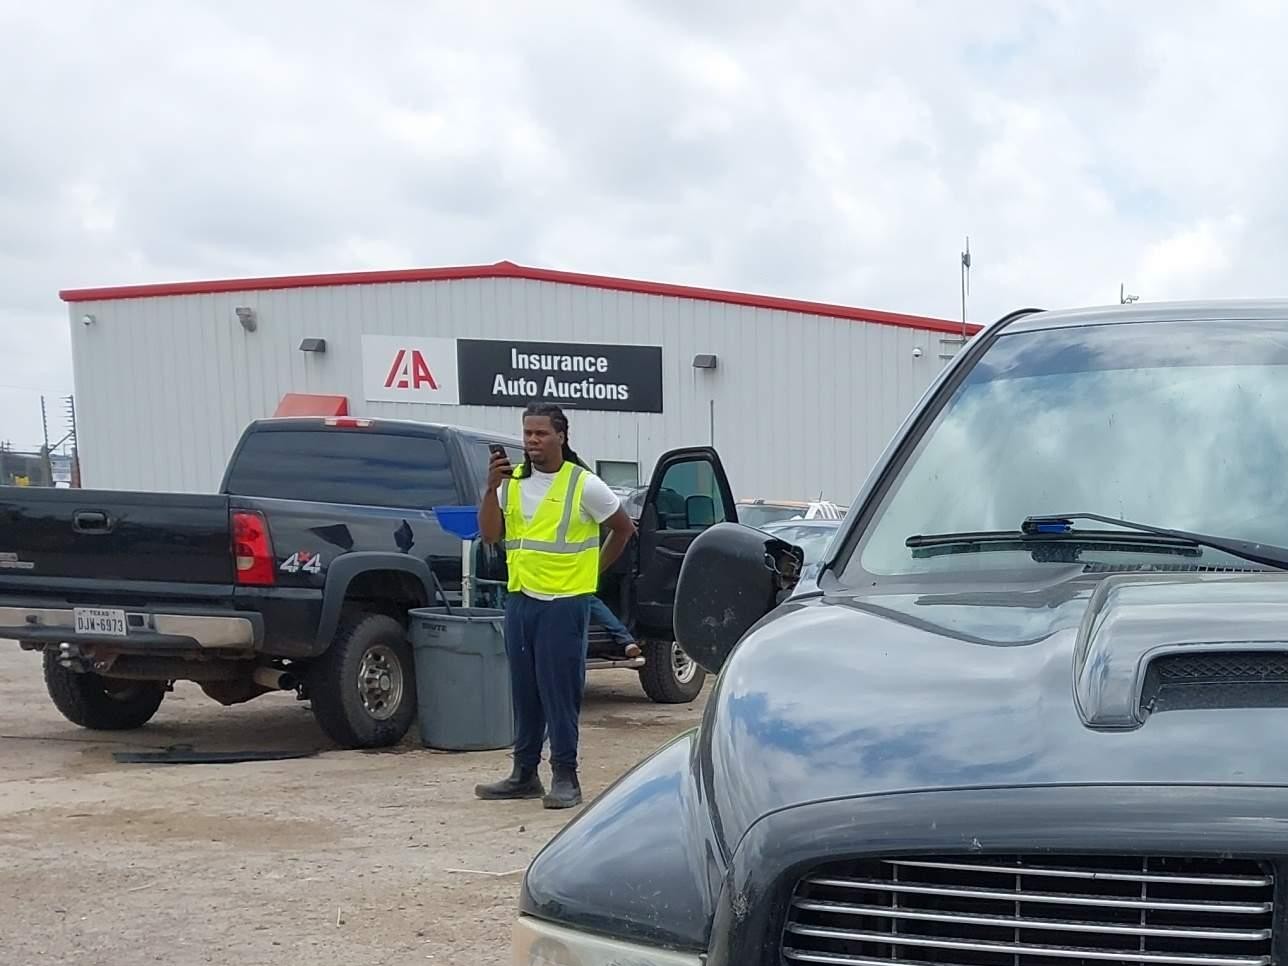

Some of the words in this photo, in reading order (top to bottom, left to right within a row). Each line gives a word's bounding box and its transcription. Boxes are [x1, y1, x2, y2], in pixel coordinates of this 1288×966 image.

[384, 349, 439, 390] IAA
[511, 348, 608, 372] Insurance
[492, 374, 537, 397] Auto
[543, 377, 629, 400] Auctions
[78, 617, 123, 632] DJW-6973
